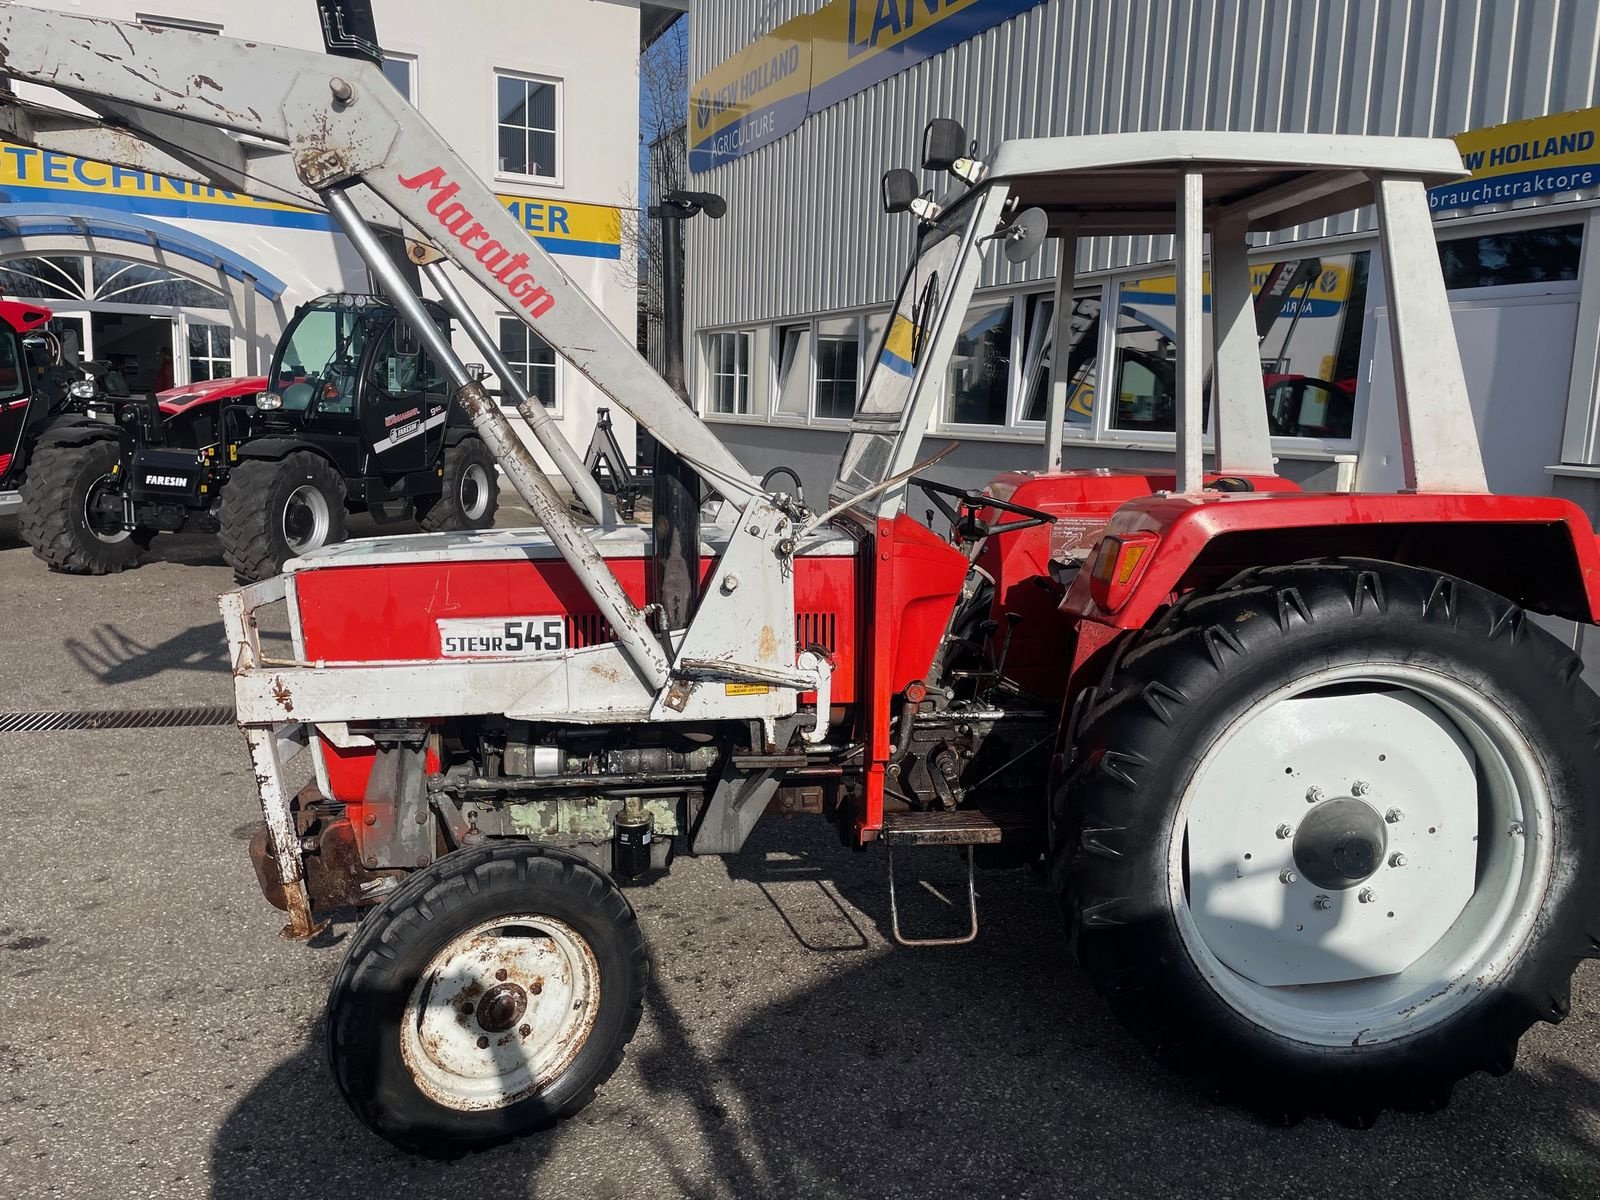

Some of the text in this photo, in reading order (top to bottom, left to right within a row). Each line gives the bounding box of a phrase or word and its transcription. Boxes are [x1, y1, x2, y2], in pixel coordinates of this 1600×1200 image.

[848, 0, 966, 61] LA
[712, 44, 799, 117] NEW HOLLAND
[711, 111, 775, 159] AGRICULTURE
[1489, 130, 1595, 167] HOLLAND
[398, 166, 555, 319] Maraton
[145, 474, 188, 487] FARESIN
[445, 621, 562, 652] STEYR 545
